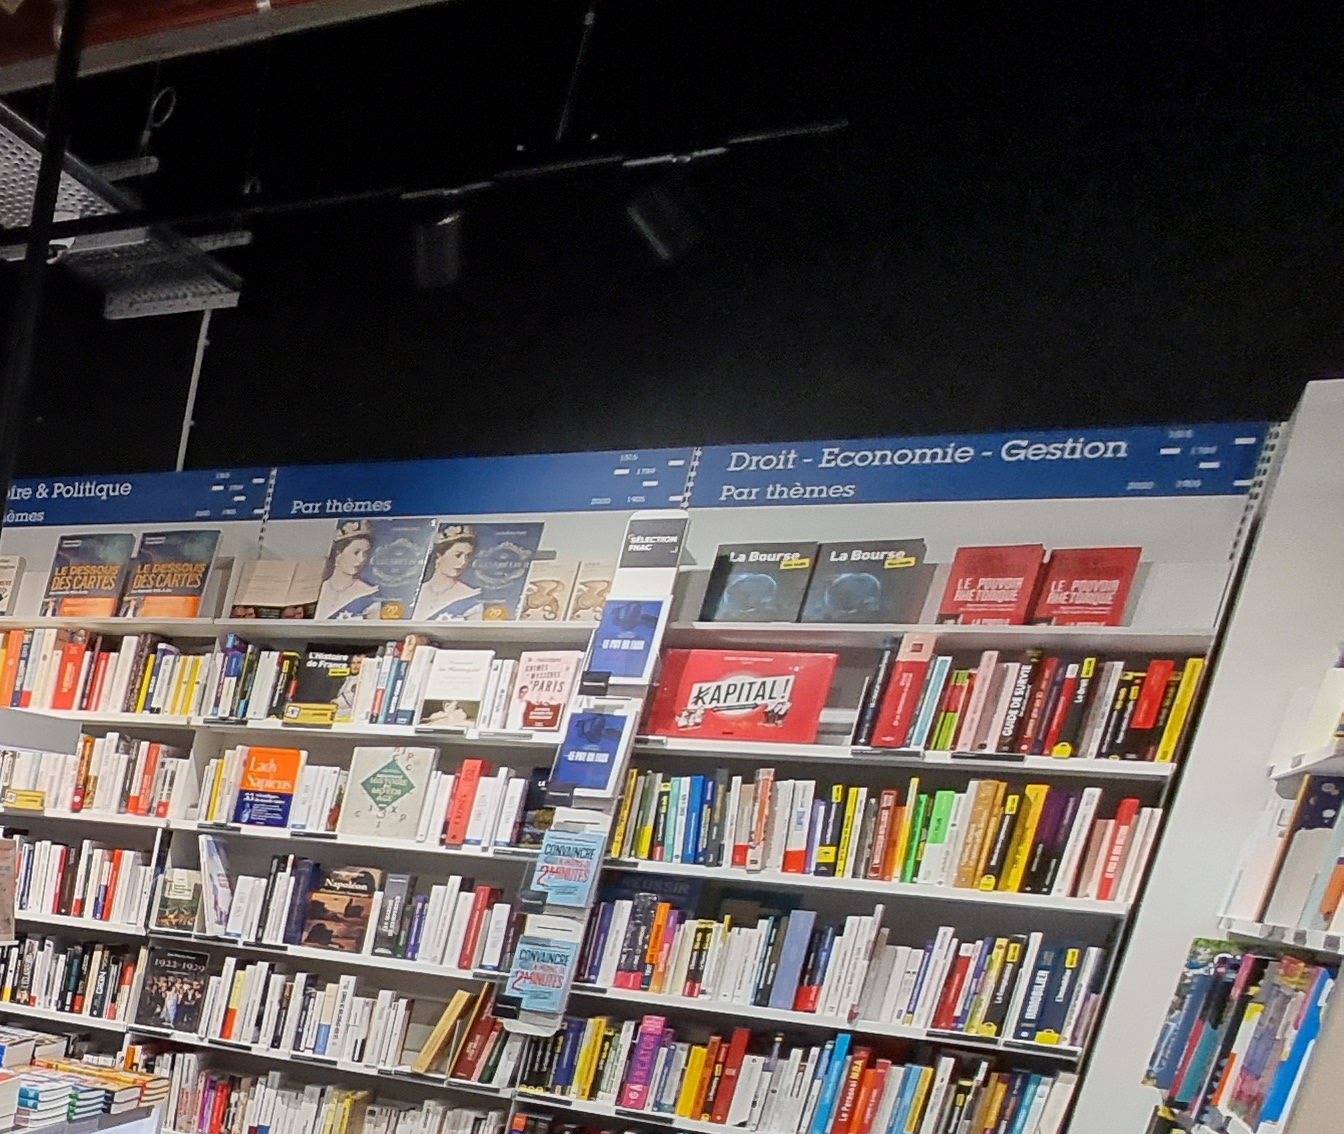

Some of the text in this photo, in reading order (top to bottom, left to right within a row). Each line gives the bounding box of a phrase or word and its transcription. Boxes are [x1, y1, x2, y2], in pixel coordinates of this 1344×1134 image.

[727, 449, 798, 472] Droit
[818, 443, 974, 469] Economie
[1002, 438, 1128, 462] Gestion
[36, 483, 49, 499] &
[51, 481, 132, 500] Politique
[719, 482, 856, 501] Par thèmes
[290, 498, 392, 515] Par thèmes
[729, 551, 801, 563] La Bourse
[830, 549, 906, 562] La Bourse
[55, 566, 69, 577] LE
[137, 563, 151, 574] LE
[51, 575, 116, 591] DES CARTES
[133, 574, 202, 590] DES CARTES
[958, 578, 972, 590] LE
[1051, 581, 1065, 593] LE
[532, 680, 565, 693] PARIS
[690, 677, 791, 709] KAPITAL!
[1002, 708, 1019, 736] GUIDE
[1014, 664, 1033, 696] SURVIE
[249, 755, 279, 774] Lady
[324, 878, 369, 892] Napoléon
